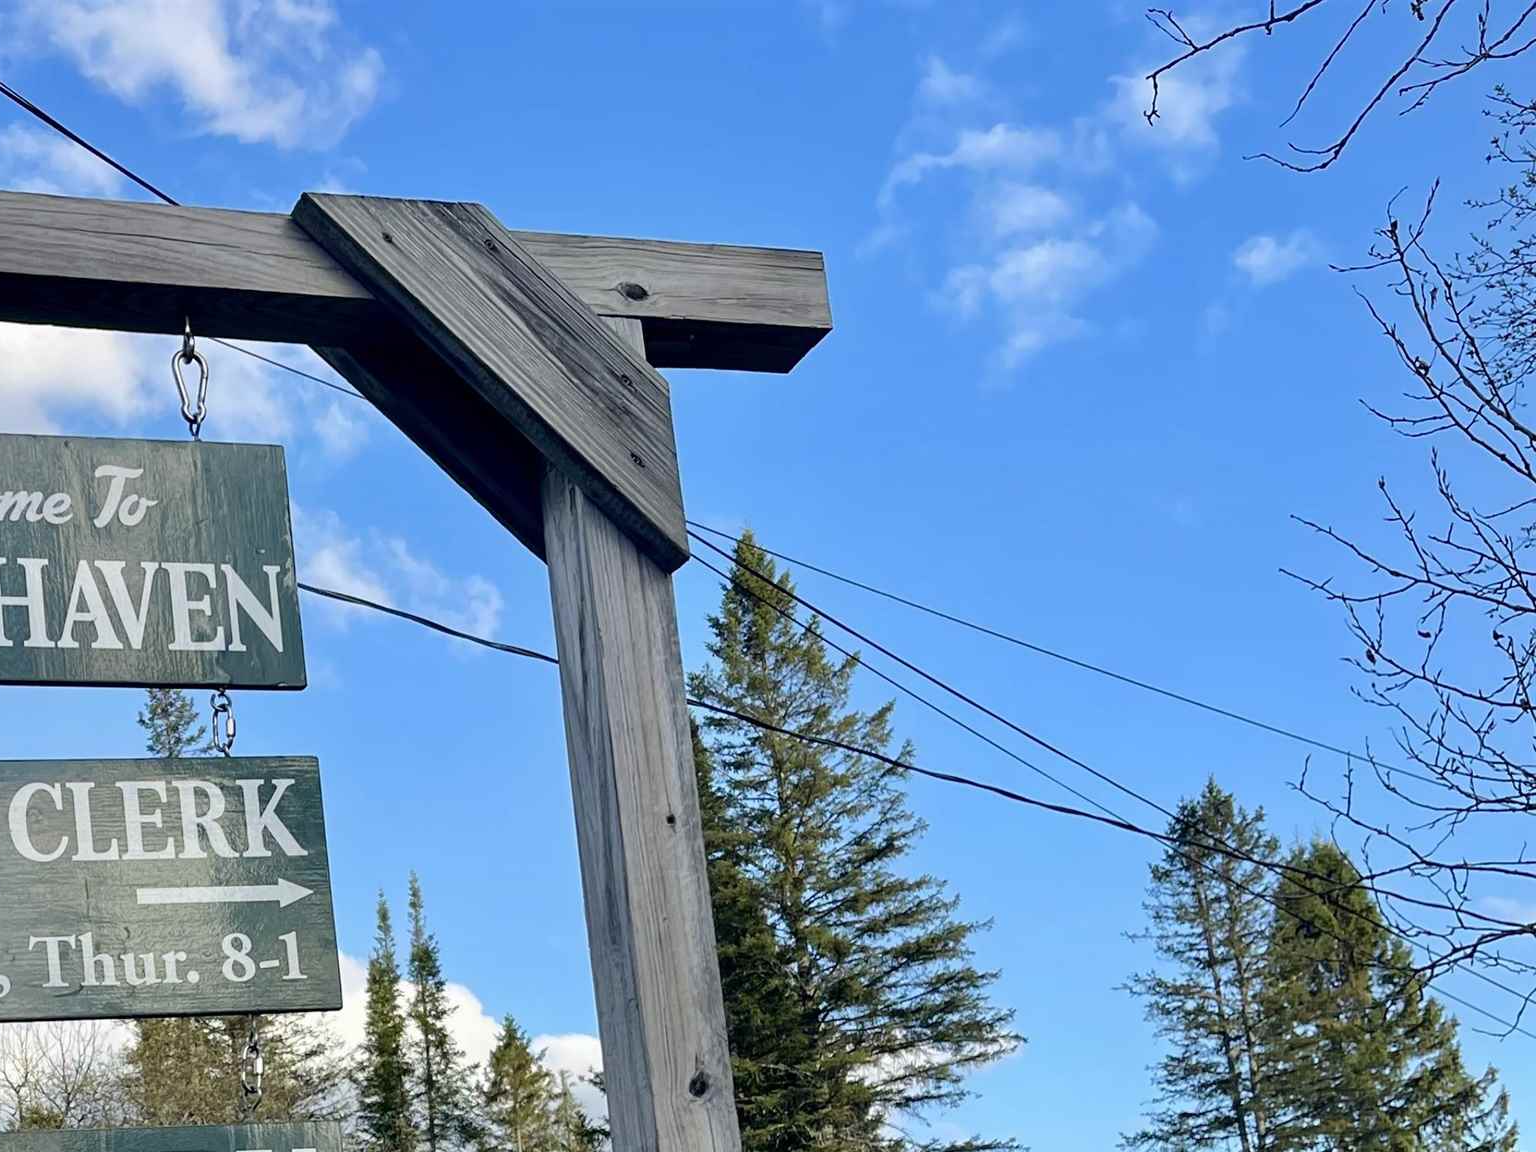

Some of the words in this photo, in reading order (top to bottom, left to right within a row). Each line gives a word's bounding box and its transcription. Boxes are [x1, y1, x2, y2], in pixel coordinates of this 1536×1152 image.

[92, 464, 159, 528] To
[7, 777, 309, 863] CLERK
[28, 933, 200, 989] Thur.
[221, 930, 308, 983] 8-1
